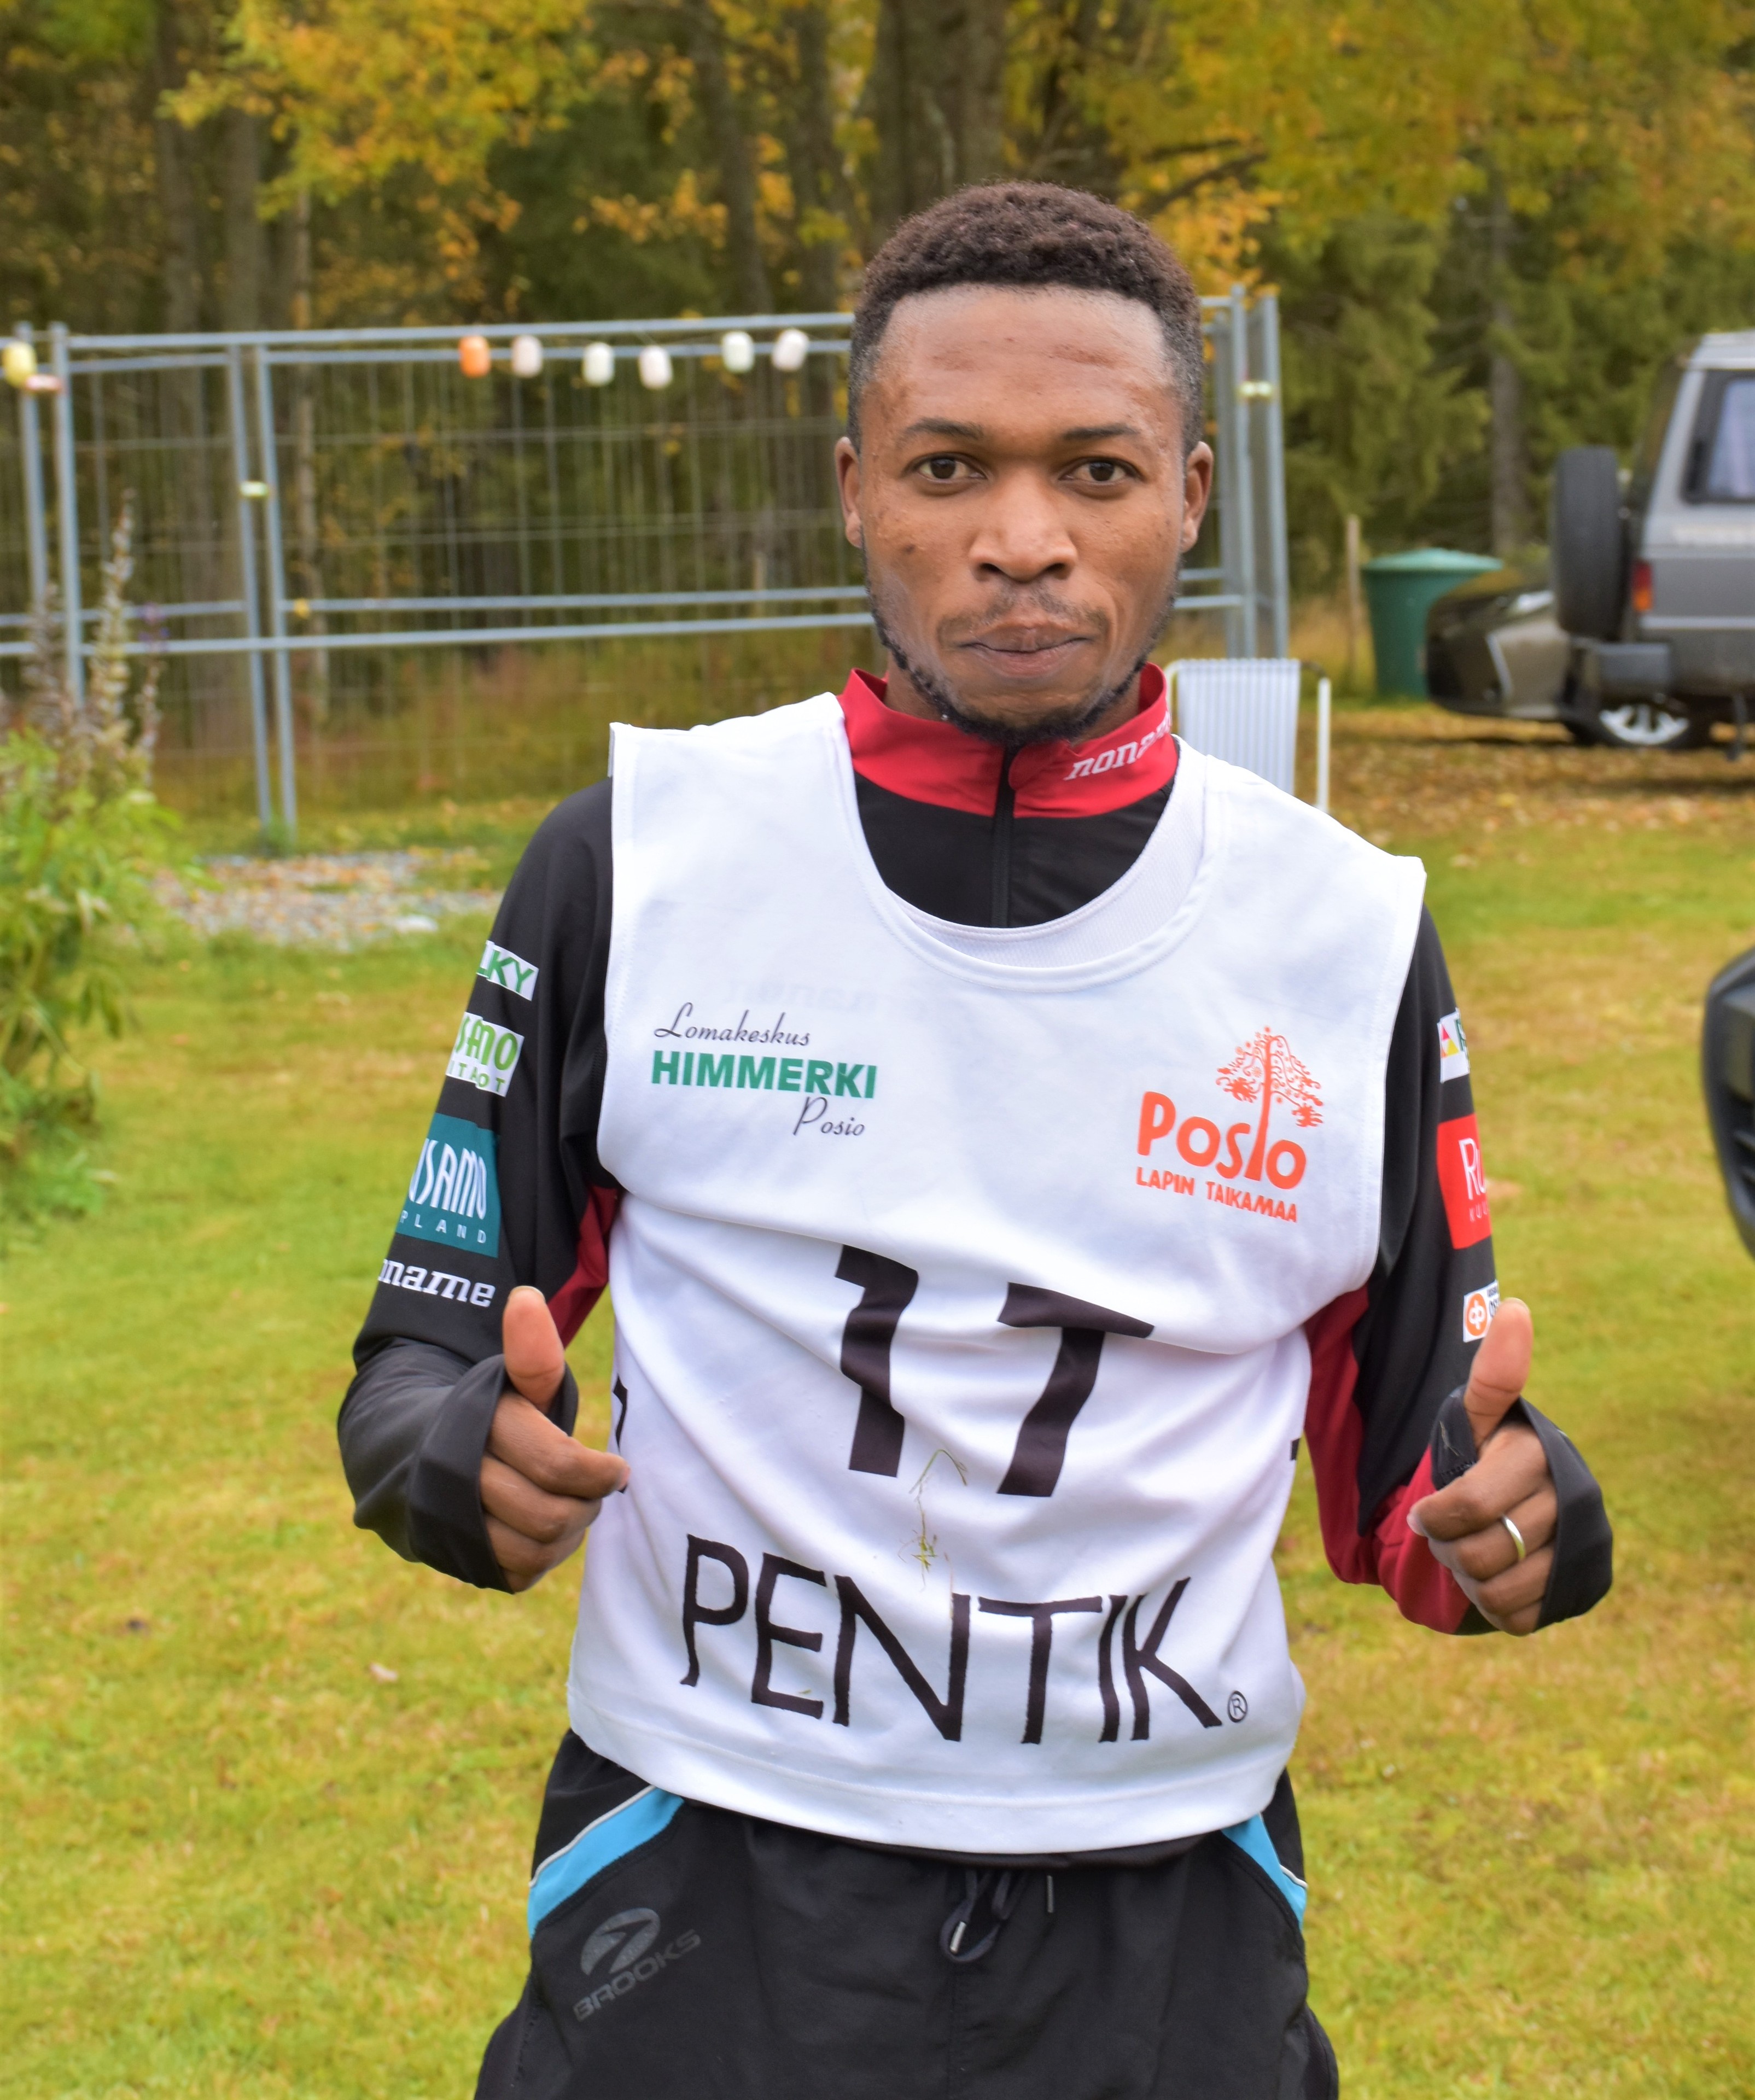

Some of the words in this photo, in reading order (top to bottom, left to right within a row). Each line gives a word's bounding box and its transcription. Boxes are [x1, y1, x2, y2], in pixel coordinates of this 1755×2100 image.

[654, 1002, 811, 1046] Lomakeskus
[651, 1049, 877, 1099] HIMMERKI
[792, 1096, 865, 1135] Posio
[1136, 1166, 1195, 1196] LAPIN
[1205, 1181, 1298, 1223] TAIKAMAA
[835, 1244, 1155, 1497] 17
[680, 1533, 1222, 1744] PENTIK
[573, 1928, 702, 2022] BROOKS
